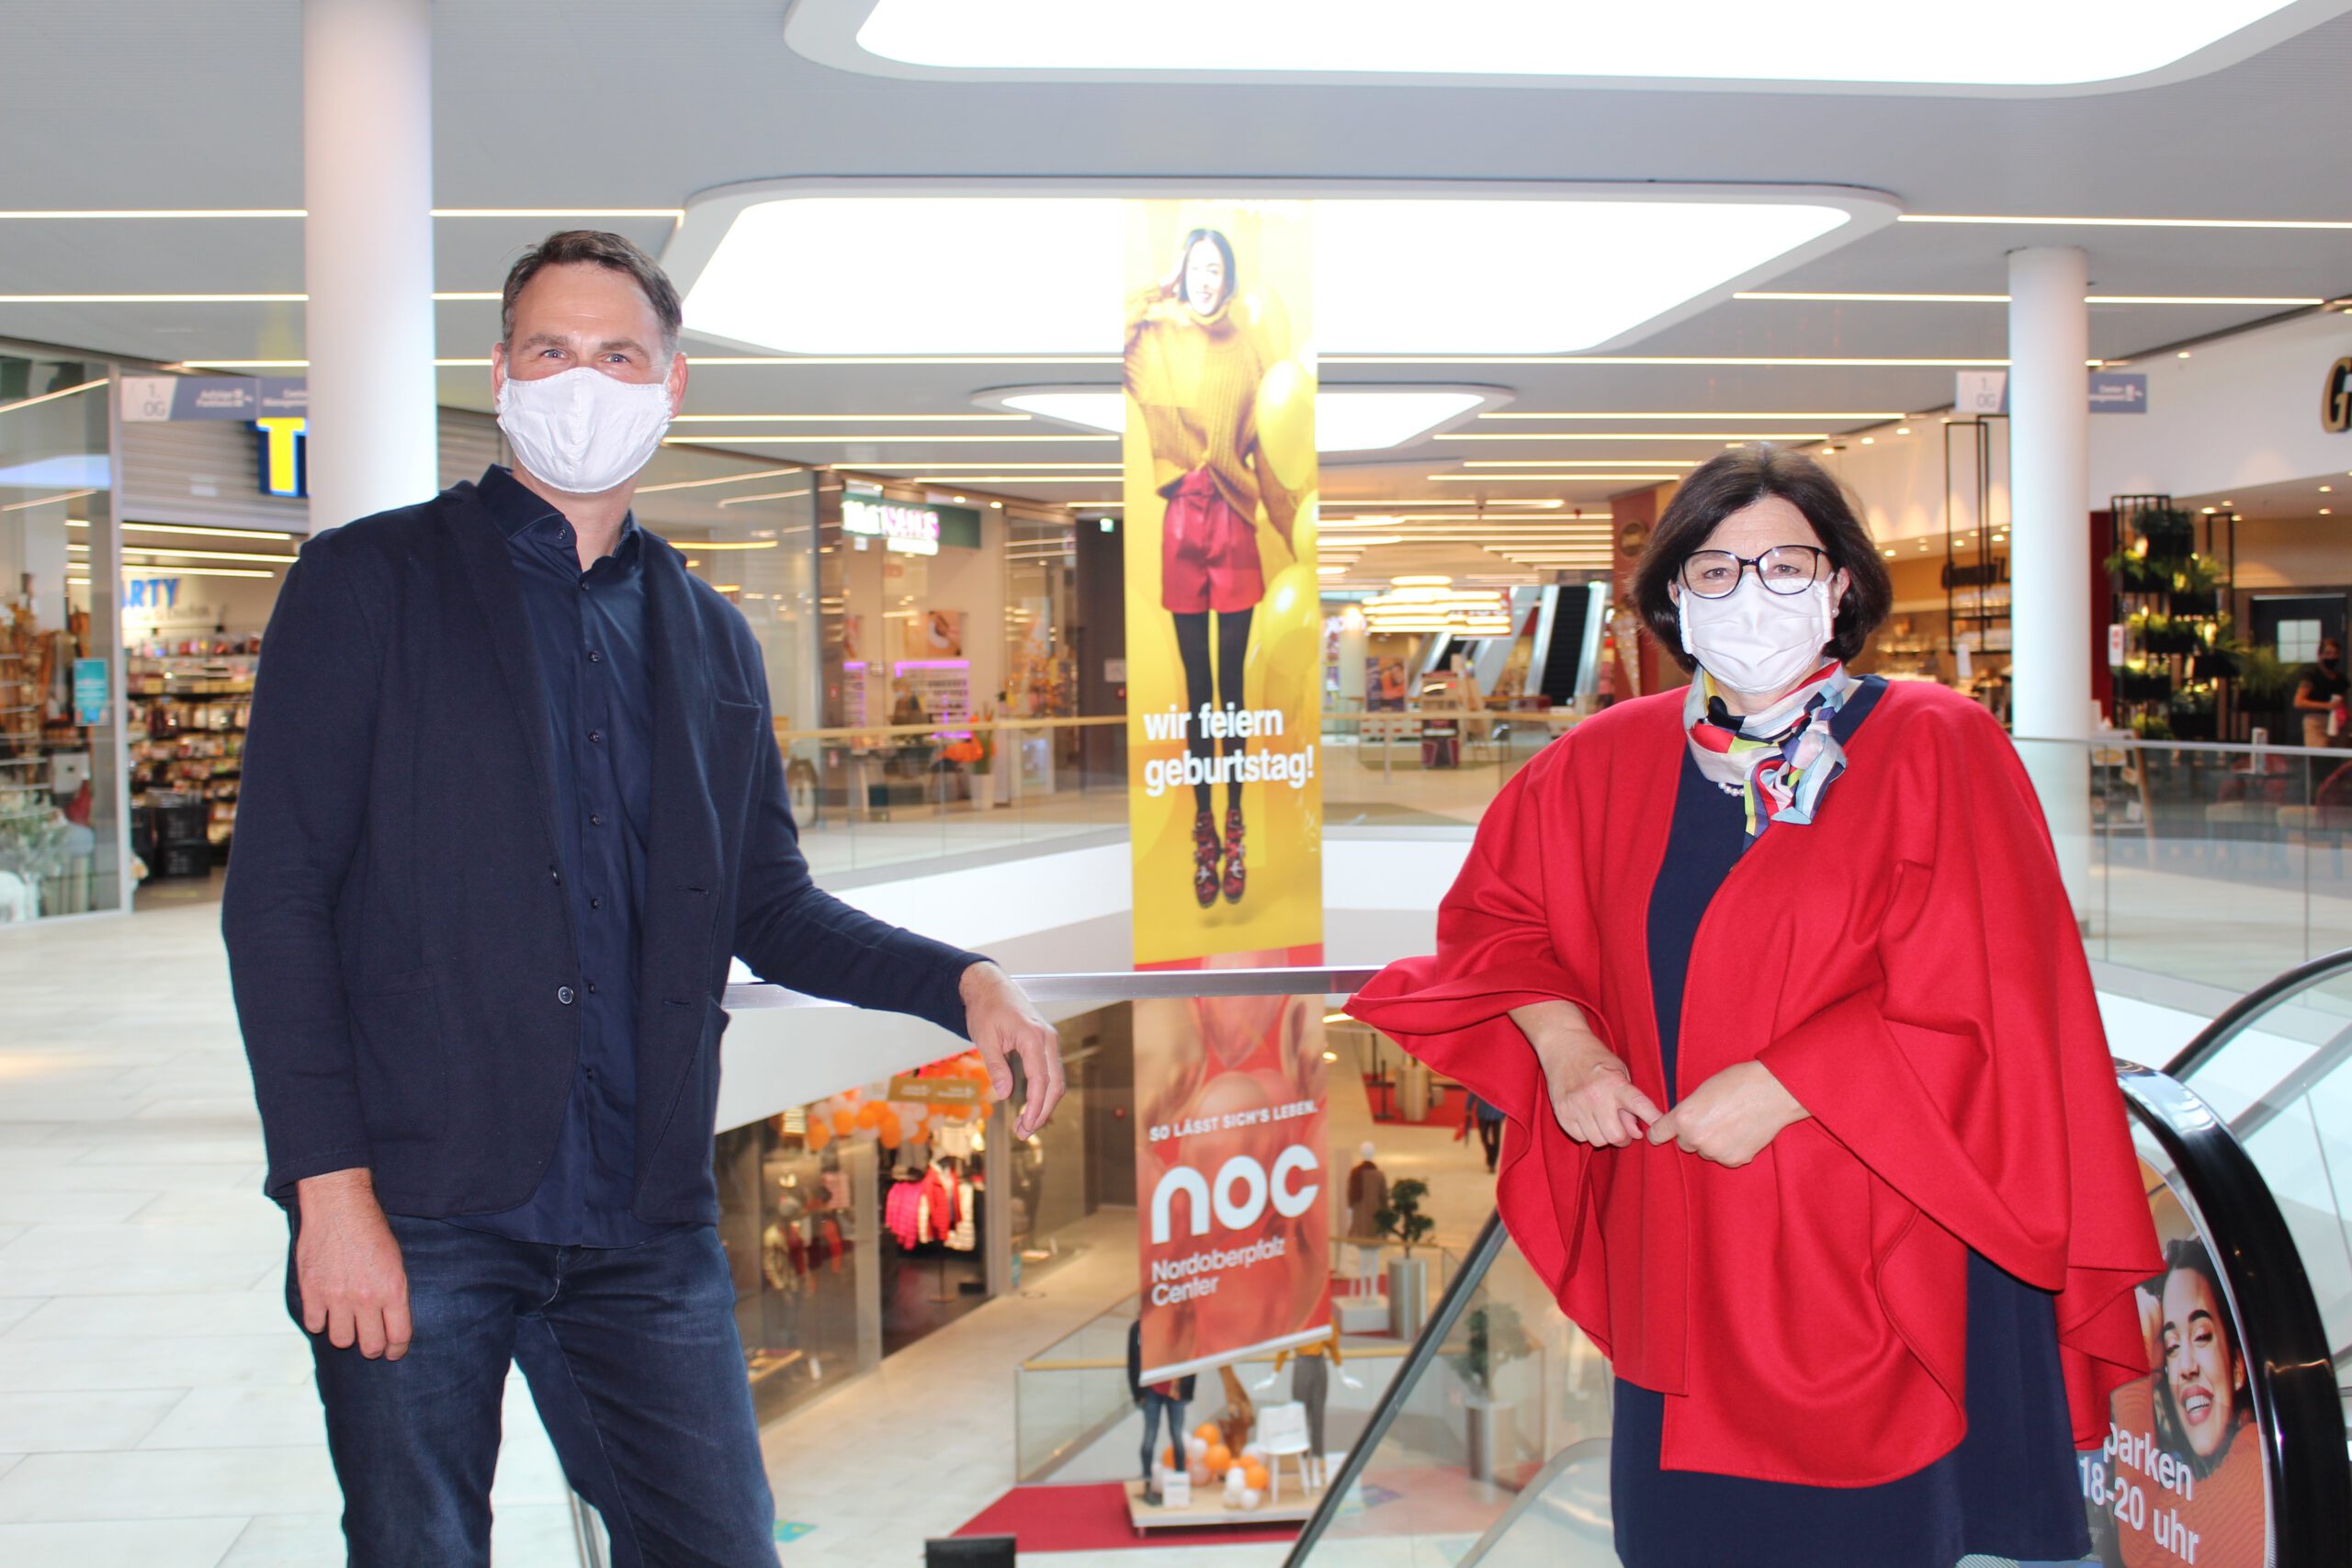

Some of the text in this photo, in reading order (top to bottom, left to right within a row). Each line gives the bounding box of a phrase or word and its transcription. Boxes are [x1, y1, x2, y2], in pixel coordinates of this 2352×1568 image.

[1143, 702, 1283, 740] wir feiern
[1144, 744, 1315, 797] geburtstag!
[1149, 1124, 1170, 1142] SO
[1223, 1107, 1270, 1129] SICH'S
[1273, 1100, 1318, 1120] LEBEN.
[1151, 1145, 1318, 1245] noc
[1151, 1235, 1285, 1282] Nordoberpfalz
[1151, 1275, 1219, 1306] Center
[2103, 1422, 2191, 1501] parken
[2079, 1456, 2199, 1565] 18-20 uhr
